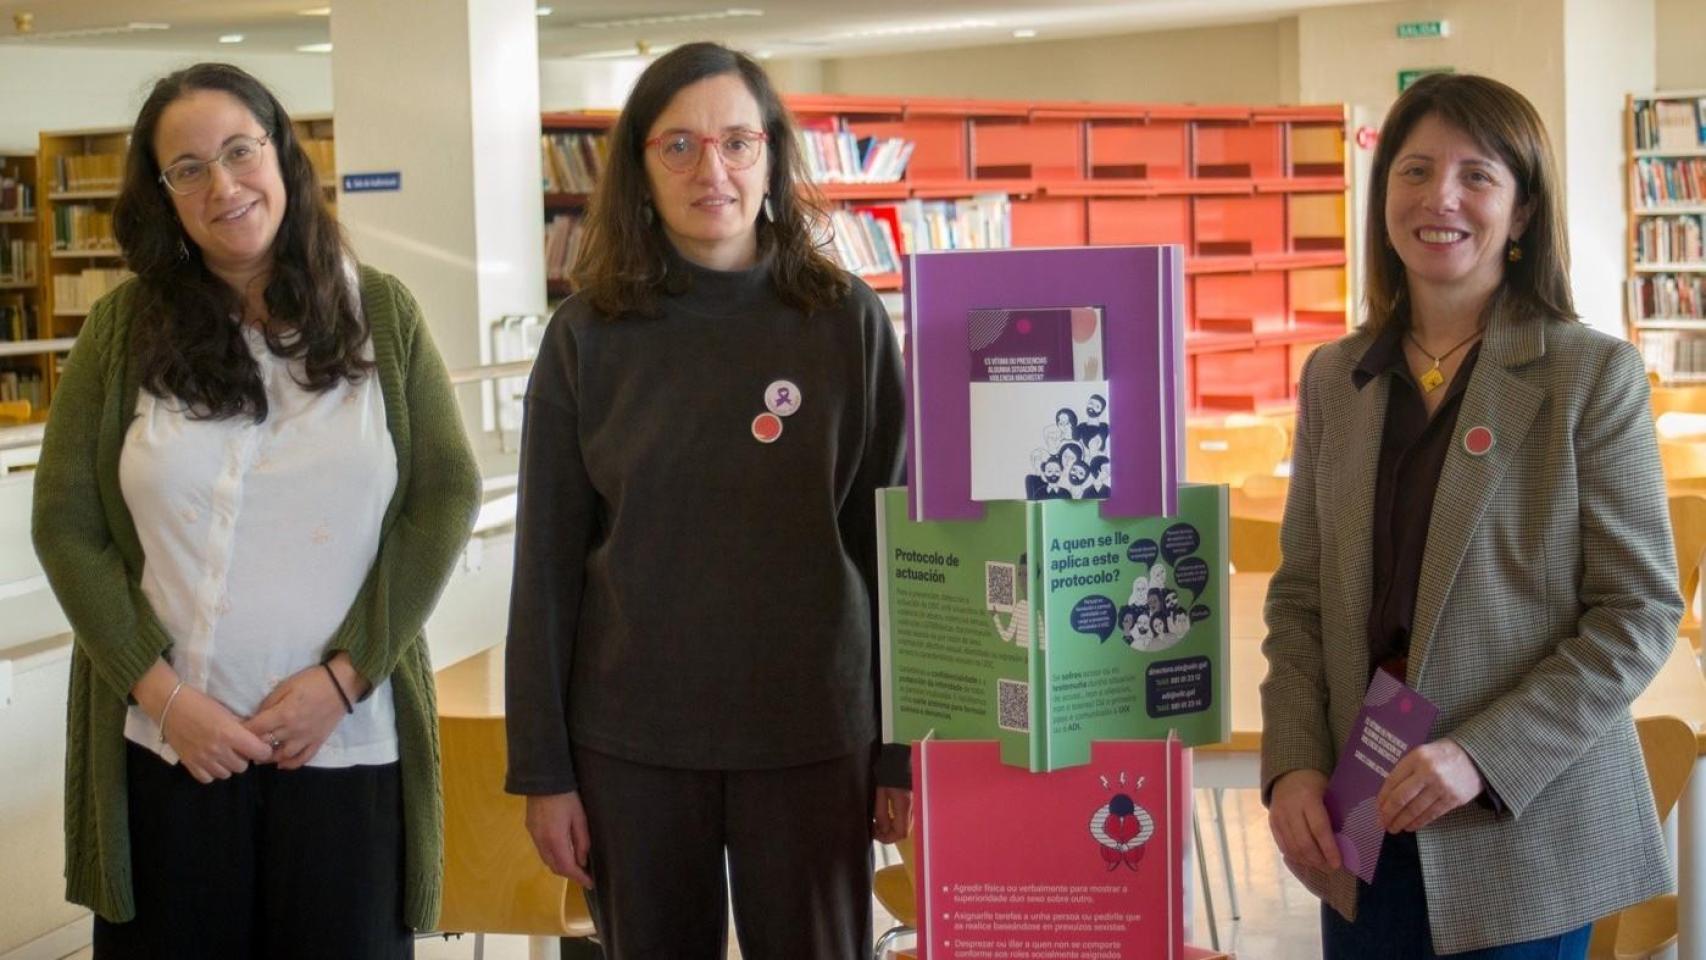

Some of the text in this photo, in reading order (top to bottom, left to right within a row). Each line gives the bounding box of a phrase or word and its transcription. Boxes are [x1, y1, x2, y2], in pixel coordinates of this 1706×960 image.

[1050, 531, 1130, 554] A quen se lle
[895, 548, 959, 567] Protocolo de
[1050, 554, 1089, 573] aplica
[1091, 552, 1119, 565] este
[895, 567, 945, 583] actuación
[1050, 570, 1120, 592] protocolo?
[953, 884, 983, 894] Agredir
[1018, 884, 1068, 893] verbalmente
[1070, 886, 1089, 894] para
[954, 895, 1008, 904] superioridade
[1009, 895, 1025, 903] dun
[1047, 895, 1069, 903] sobre
[954, 911, 994, 921] Asignarlle
[995, 912, 1023, 920] tarefas
[1030, 912, 1051, 920] unha
[1053, 913, 1080, 922] persoa
[1125, 914, 1142, 922] que
[965, 922, 992, 930] realice
[954, 940, 994, 949] Desprezar
[1032, 941, 1052, 950] quen
[1082, 942, 1122, 950] comporte
[954, 950, 992, 958] conforme
[1010, 950, 1029, 958] roles
[1031, 950, 1079, 959] socialmente
[1080, 951, 1122, 960] asignados
